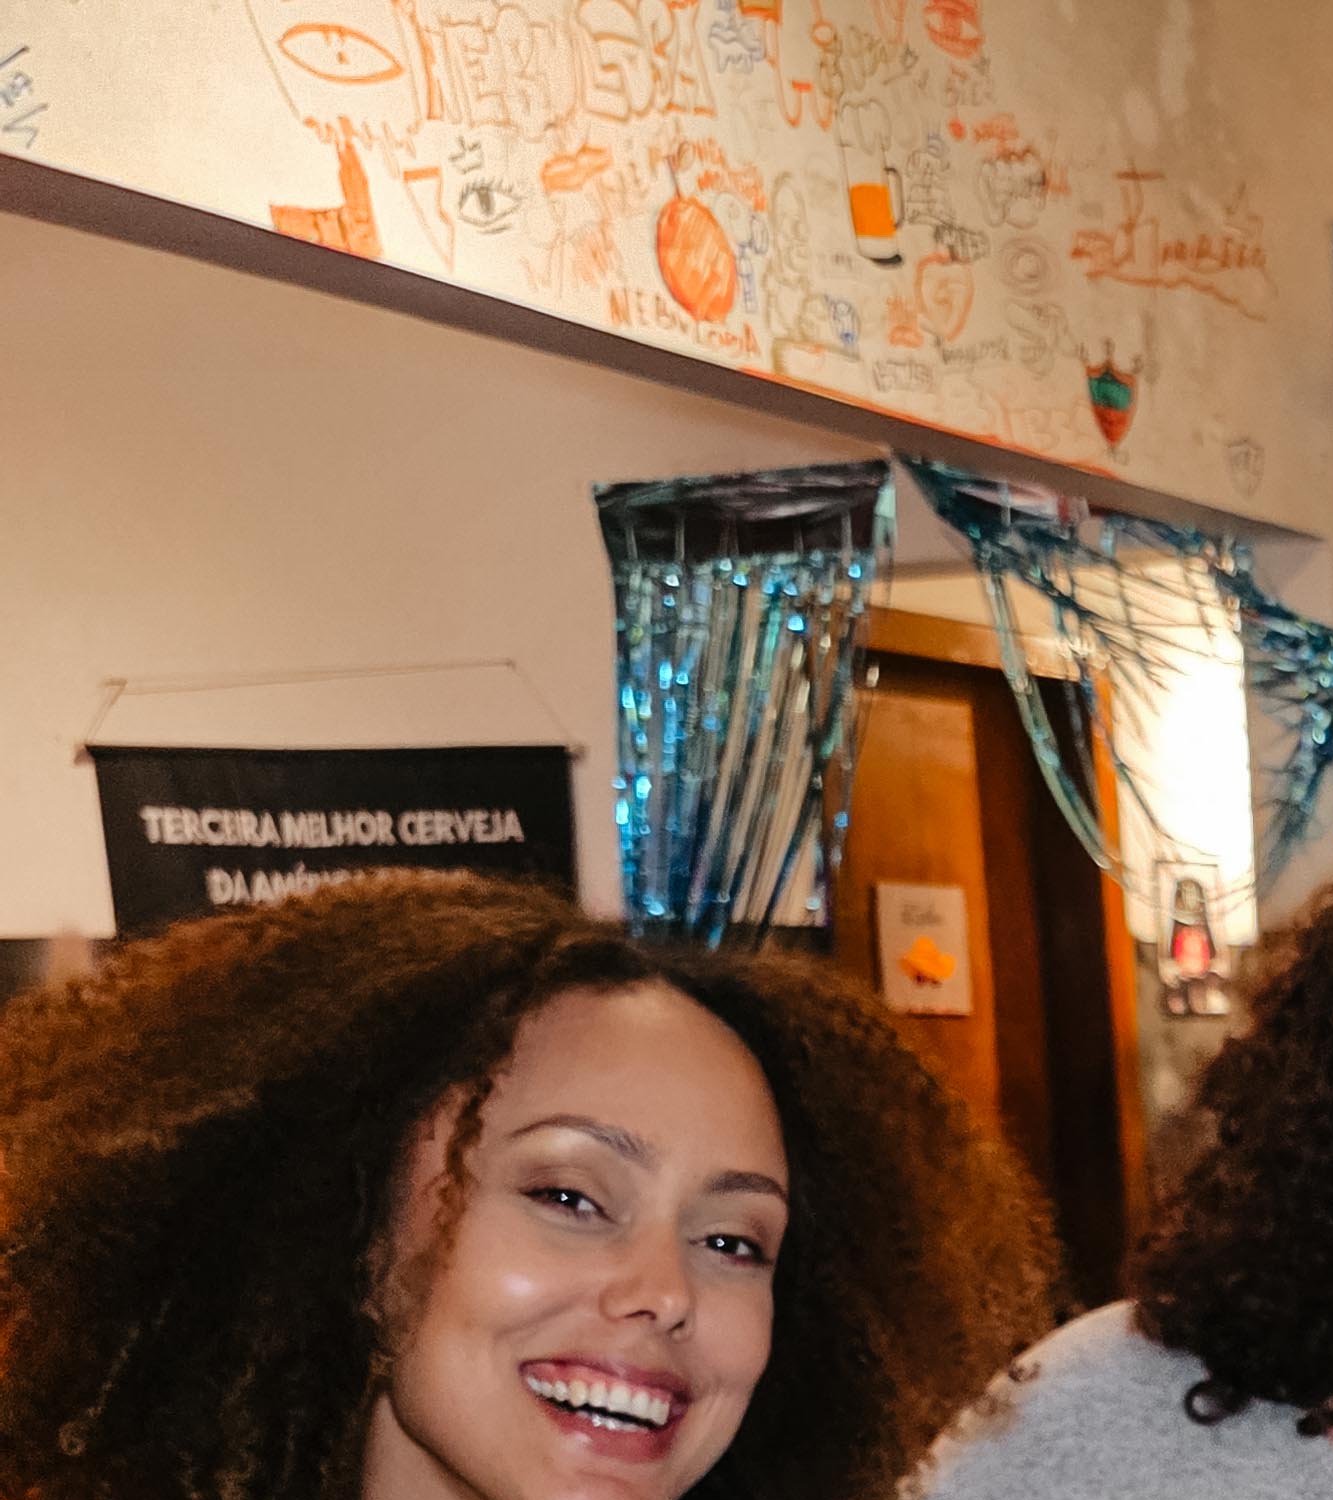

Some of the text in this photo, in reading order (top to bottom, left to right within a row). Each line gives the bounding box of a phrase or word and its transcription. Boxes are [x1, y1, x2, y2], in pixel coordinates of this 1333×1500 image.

[139, 805, 525, 848] TERCEIRA MELHOR CERVEJA
[206, 868, 251, 905] DA
